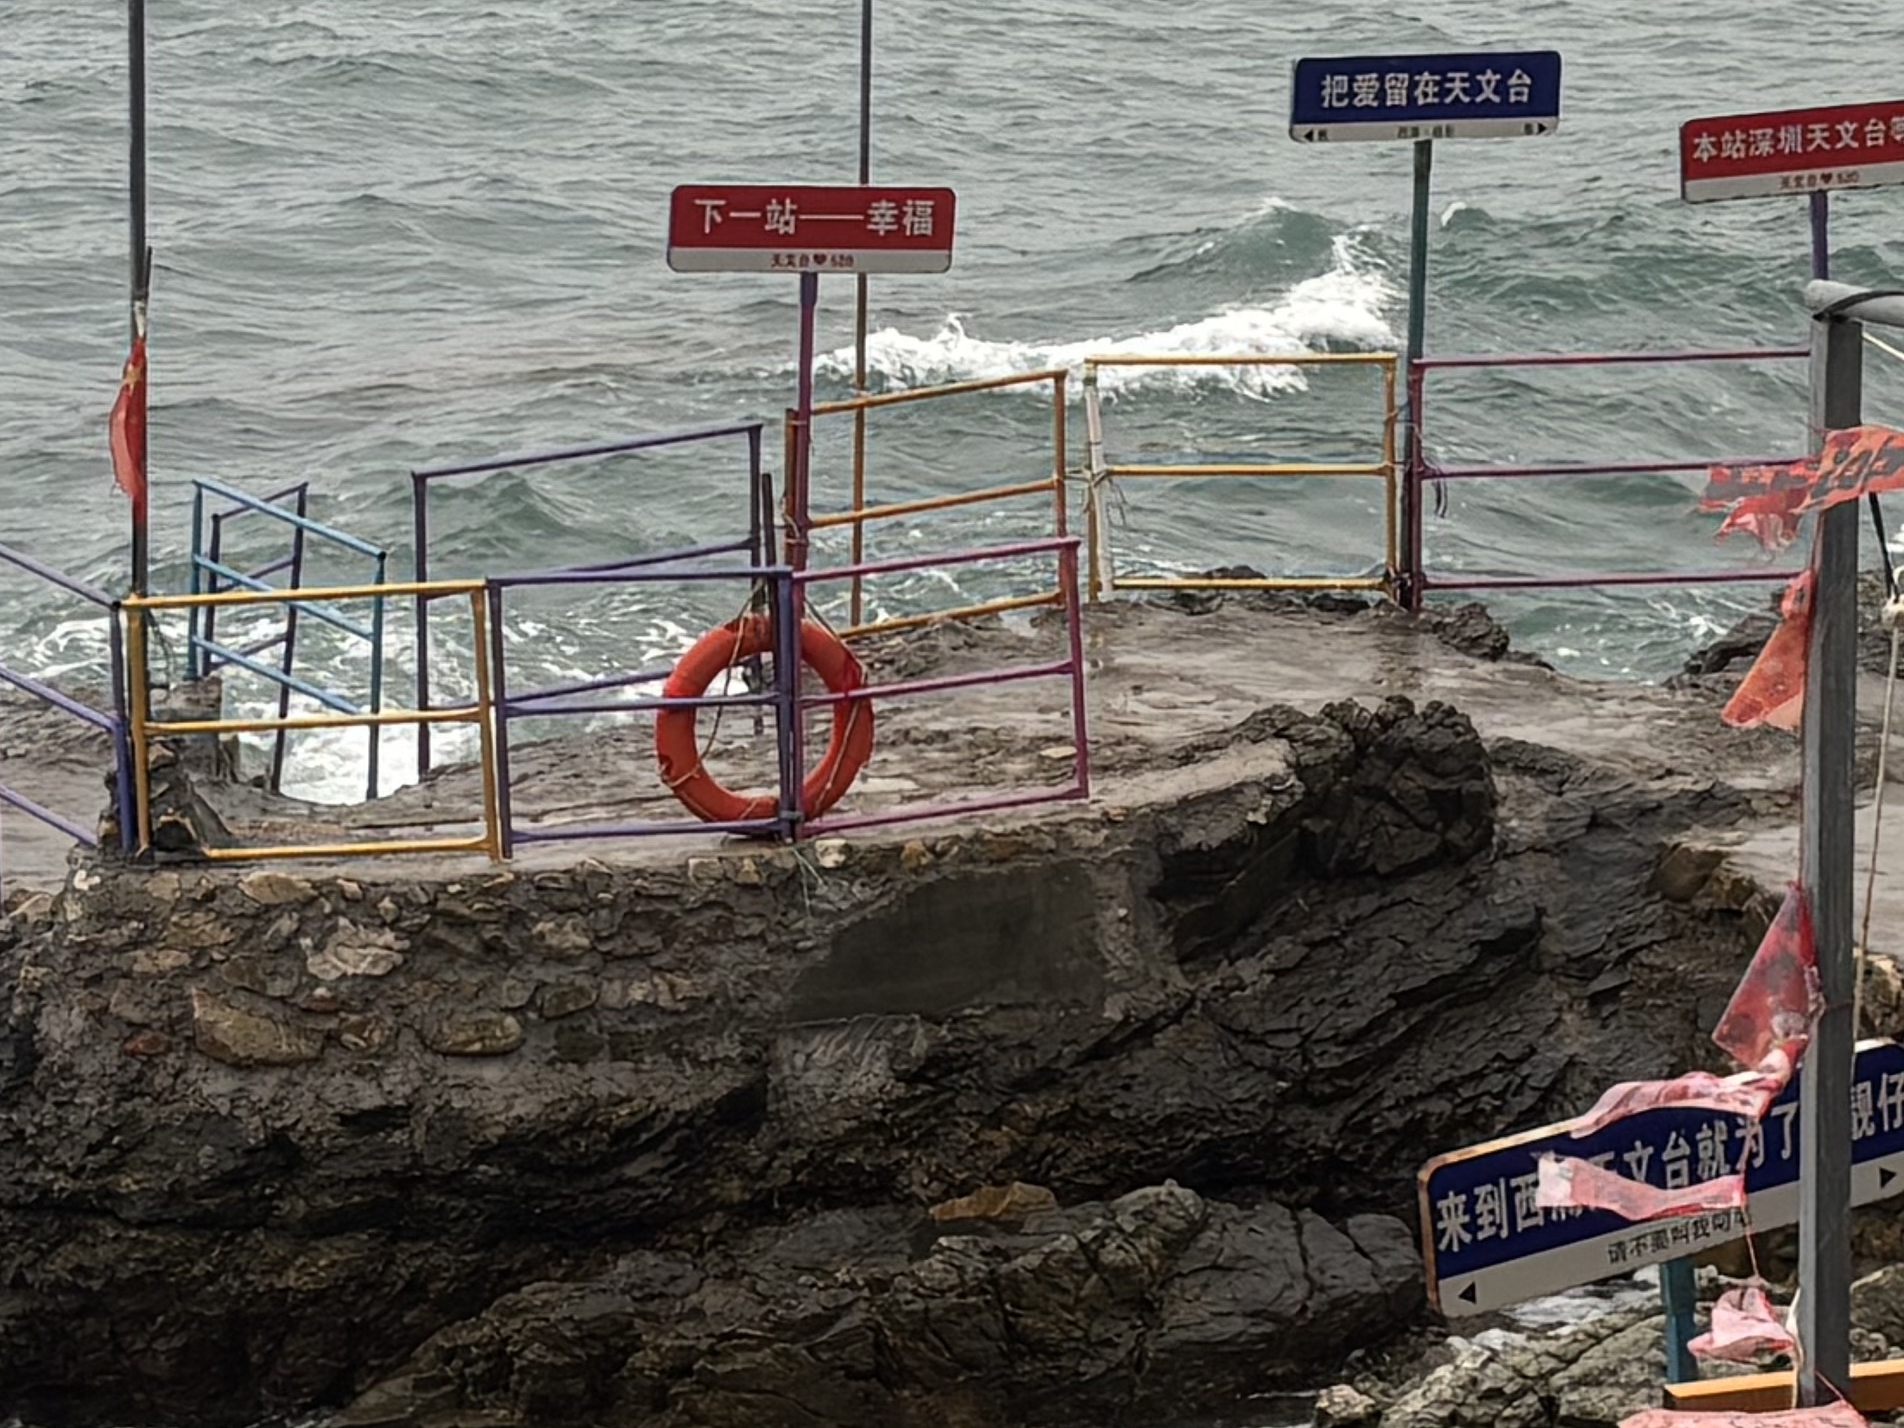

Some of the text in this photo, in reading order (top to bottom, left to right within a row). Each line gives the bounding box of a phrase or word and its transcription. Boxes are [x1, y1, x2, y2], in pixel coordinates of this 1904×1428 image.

[1320, 68, 1532, 108] 把爱留在天文台
